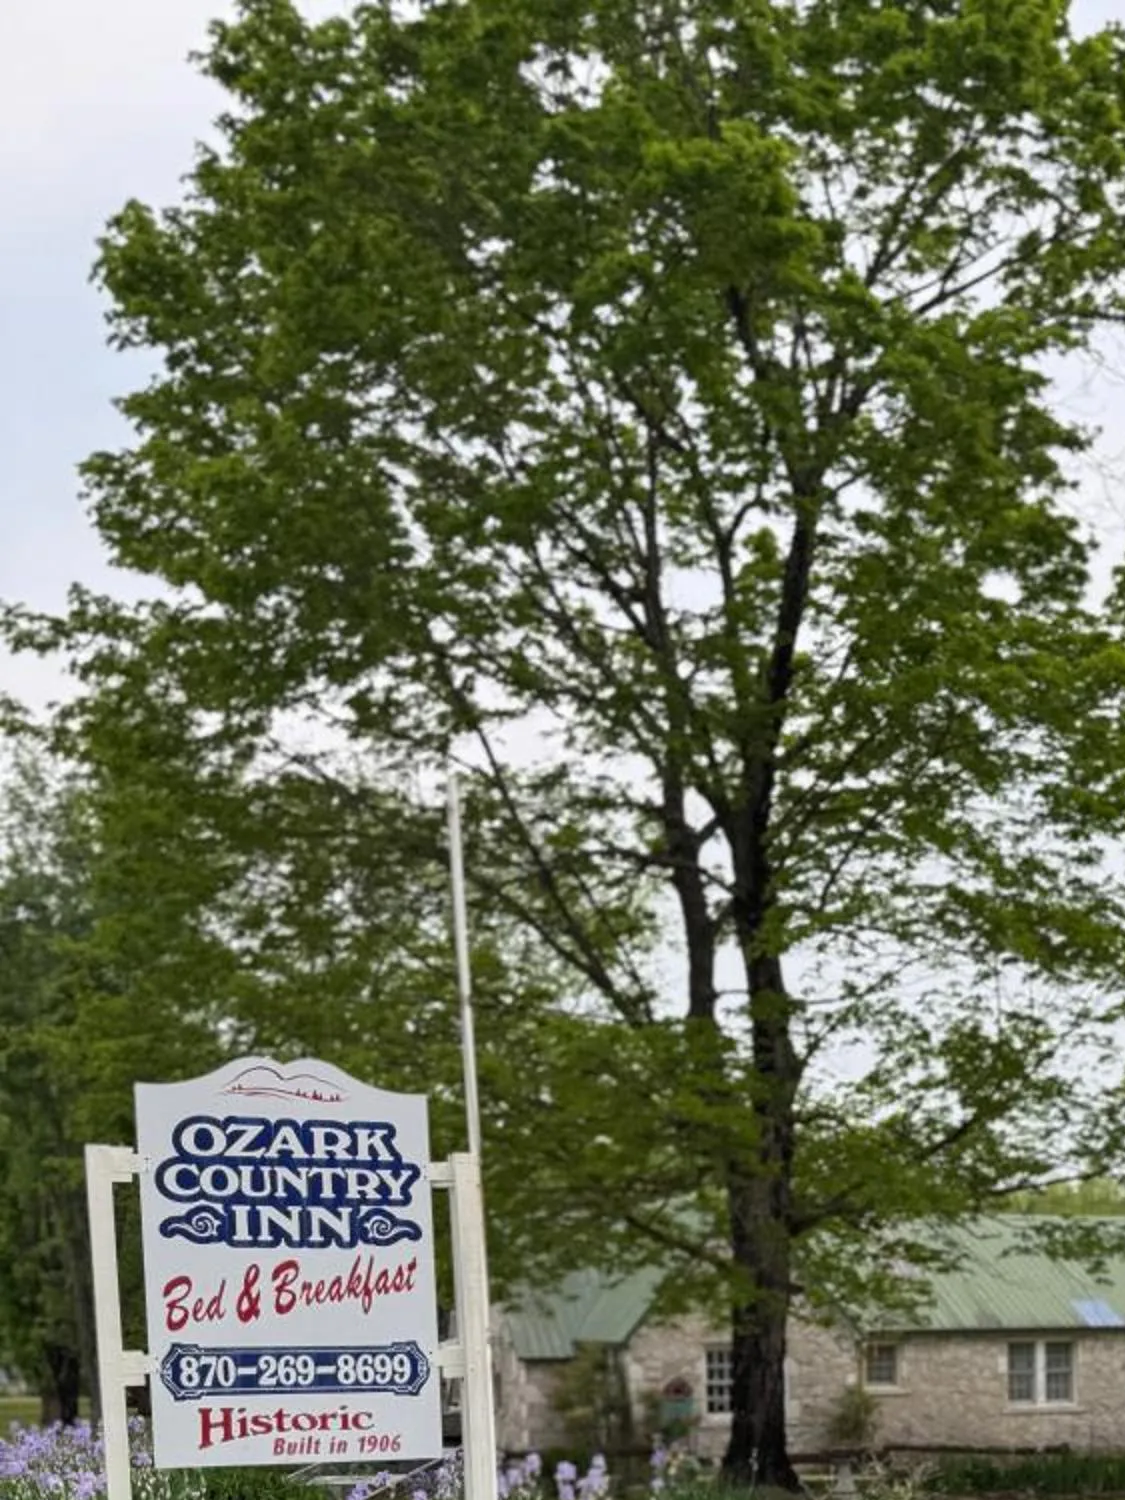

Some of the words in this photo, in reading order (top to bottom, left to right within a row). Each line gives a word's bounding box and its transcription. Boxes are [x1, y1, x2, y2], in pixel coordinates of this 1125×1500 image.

[180, 1122, 394, 1161] OZARK
[162, 1163, 413, 1202] COUNTRY
[232, 1205, 354, 1243] INN
[162, 1275, 226, 1331] Bed
[236, 1264, 261, 1323] &
[270, 1255, 418, 1315] Breakfast
[178, 1354, 412, 1389] 870-269-8699
[198, 1405, 373, 1450] Historic
[272, 1437, 321, 1456] Built
[328, 1436, 349, 1453] in
[358, 1435, 401, 1453] 1906
